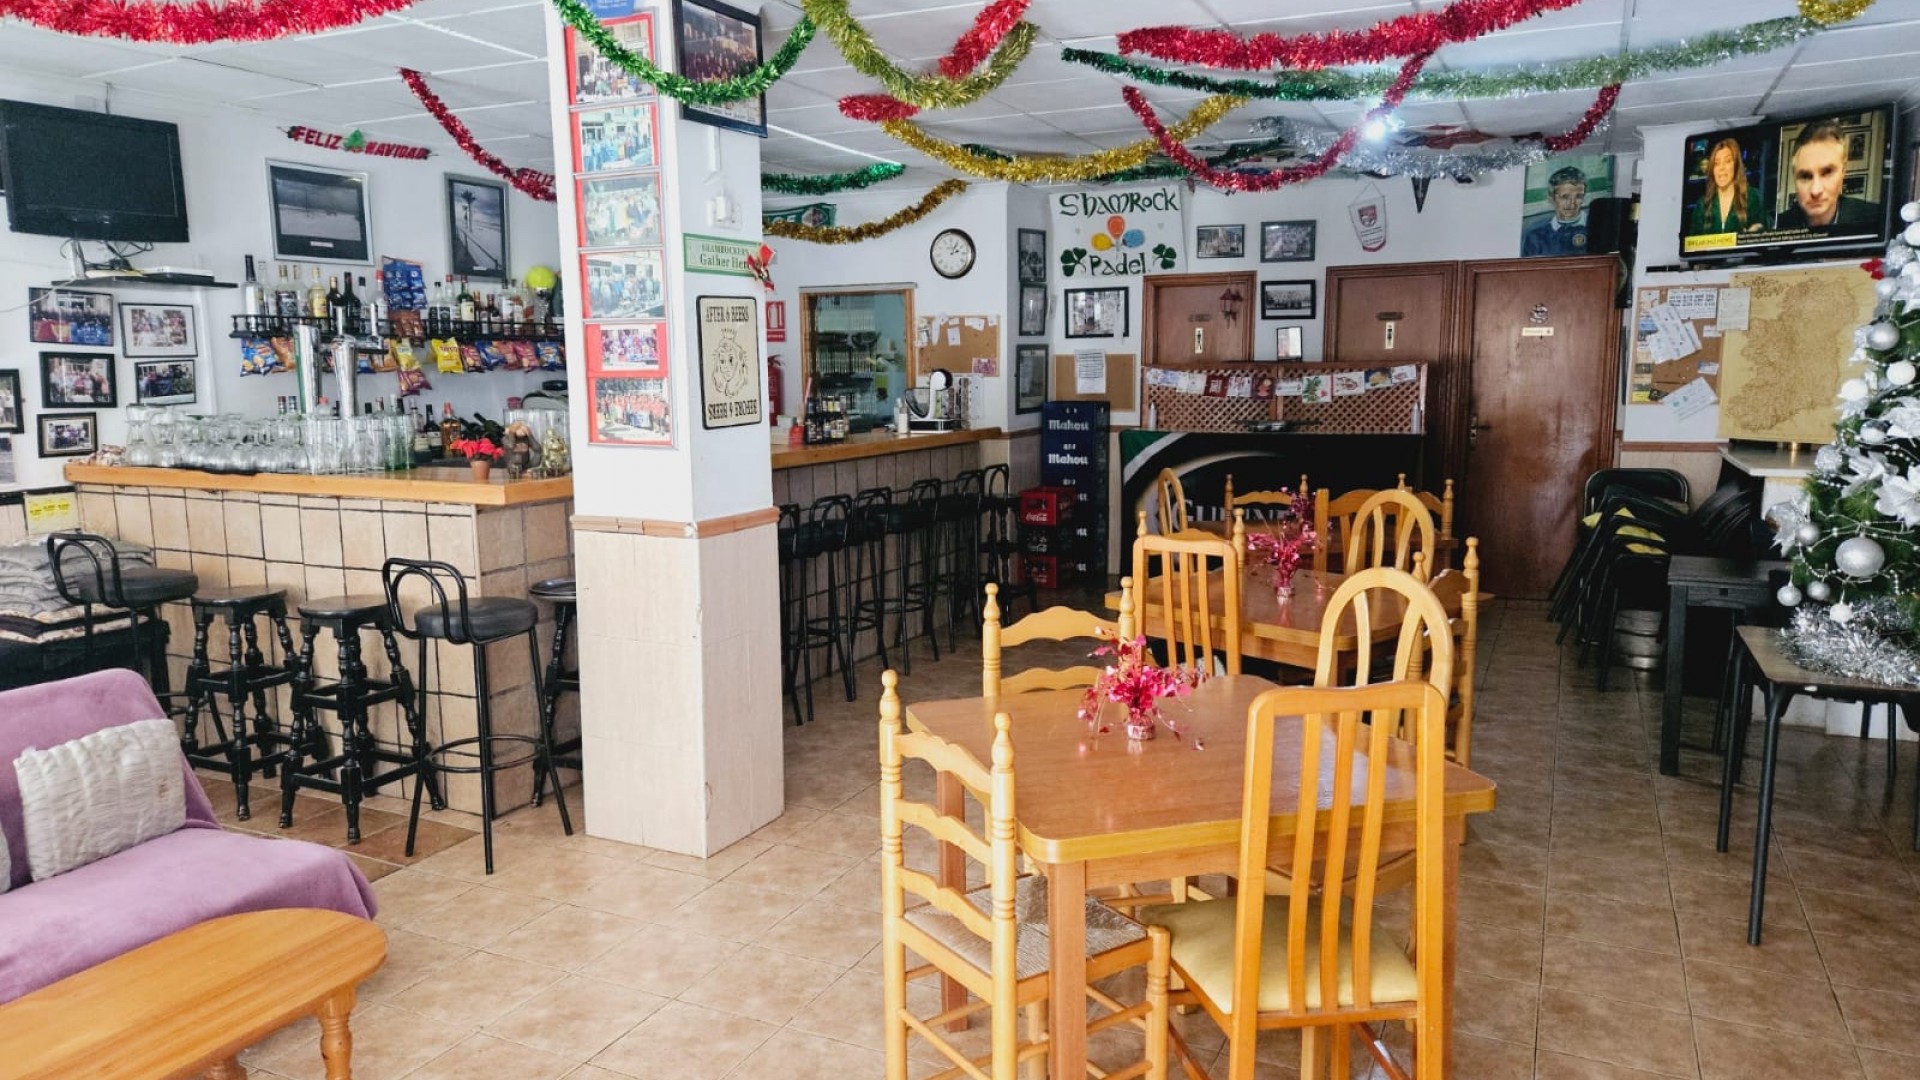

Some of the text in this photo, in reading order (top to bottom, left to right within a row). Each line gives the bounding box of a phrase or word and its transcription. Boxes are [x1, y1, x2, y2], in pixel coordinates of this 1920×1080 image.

[293, 126, 343, 150] FELIZ
[1049, 420, 1089, 431] Mahou
[1048, 453, 1088, 465] Mahou
